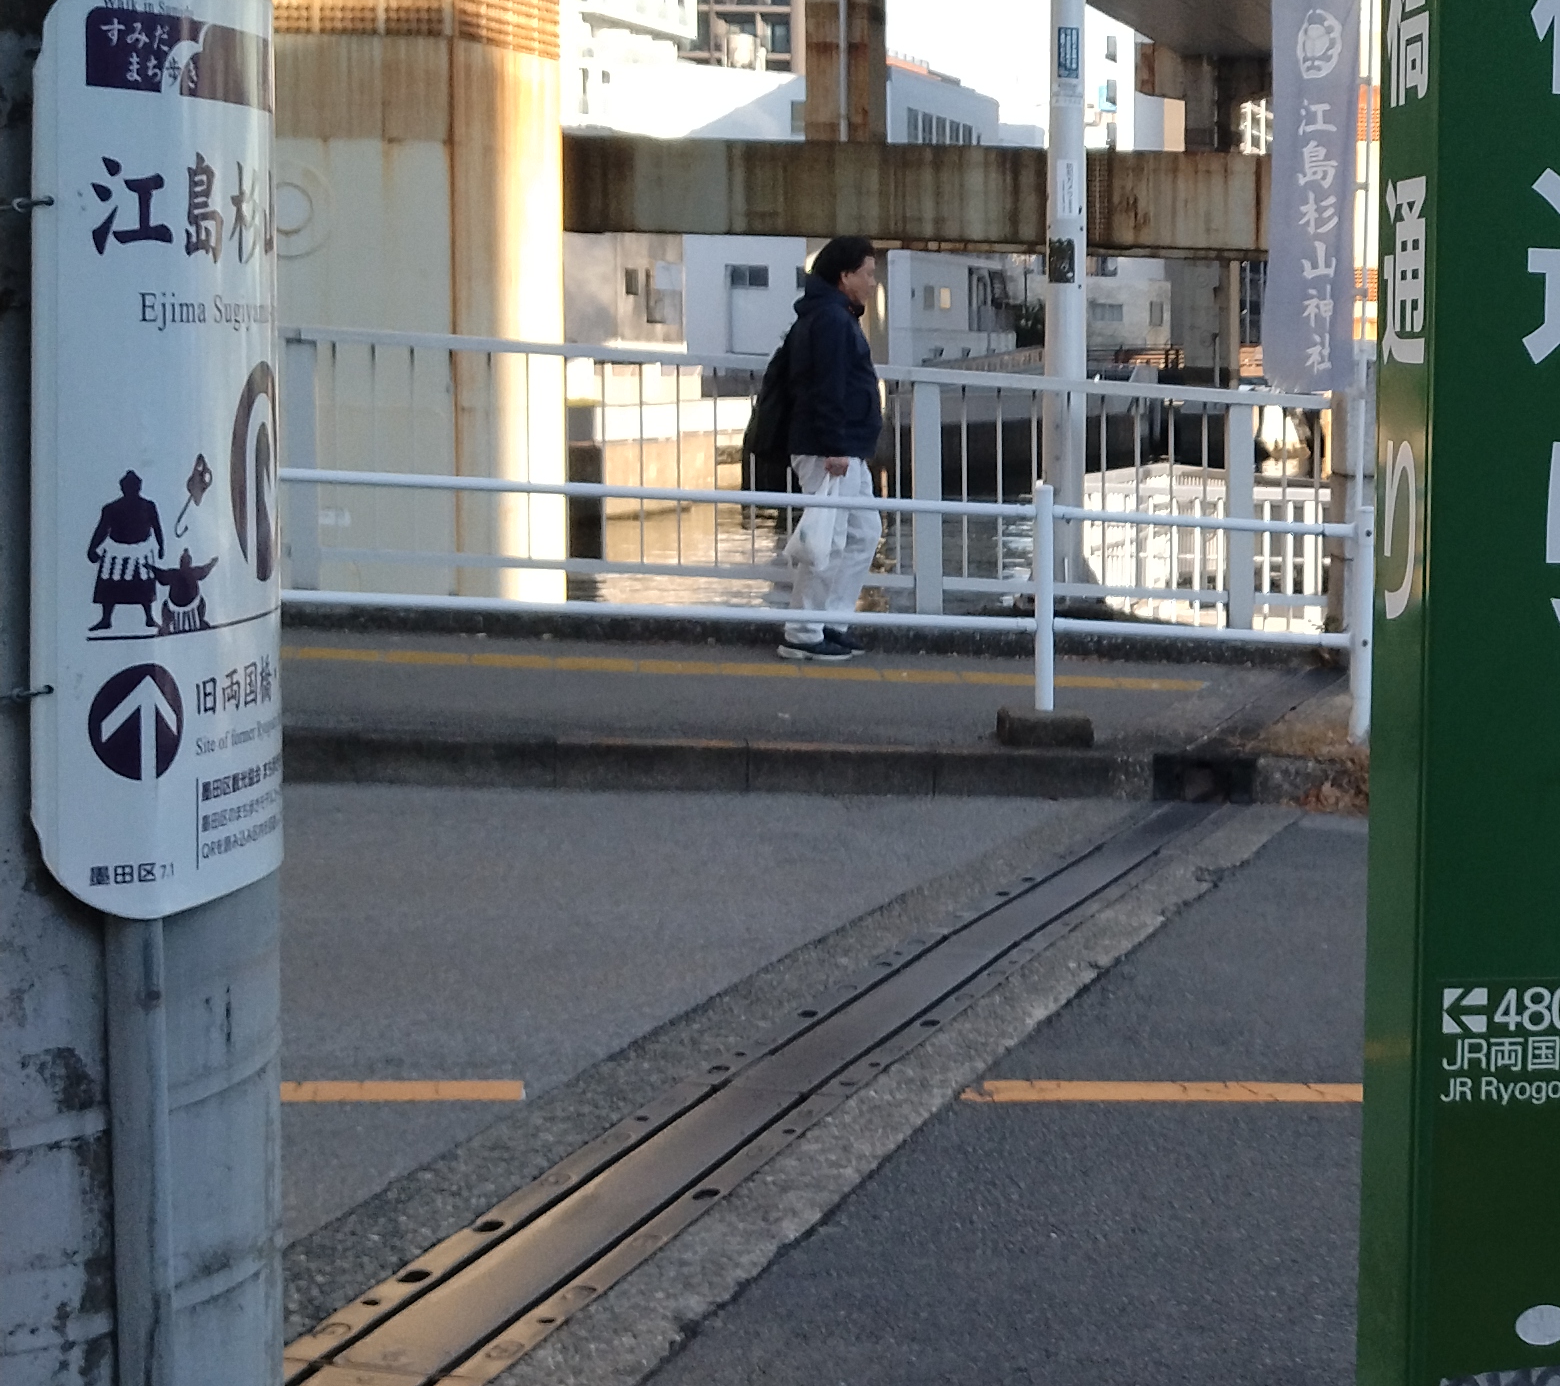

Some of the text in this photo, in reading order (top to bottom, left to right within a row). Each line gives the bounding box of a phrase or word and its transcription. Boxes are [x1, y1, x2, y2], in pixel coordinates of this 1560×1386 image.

[100, 18, 170, 52] すみだ
[1297, 99, 1340, 376] 江島杉山神社
[139, 291, 207, 332] Ejima
[1440, 1076, 1472, 1103] JR
